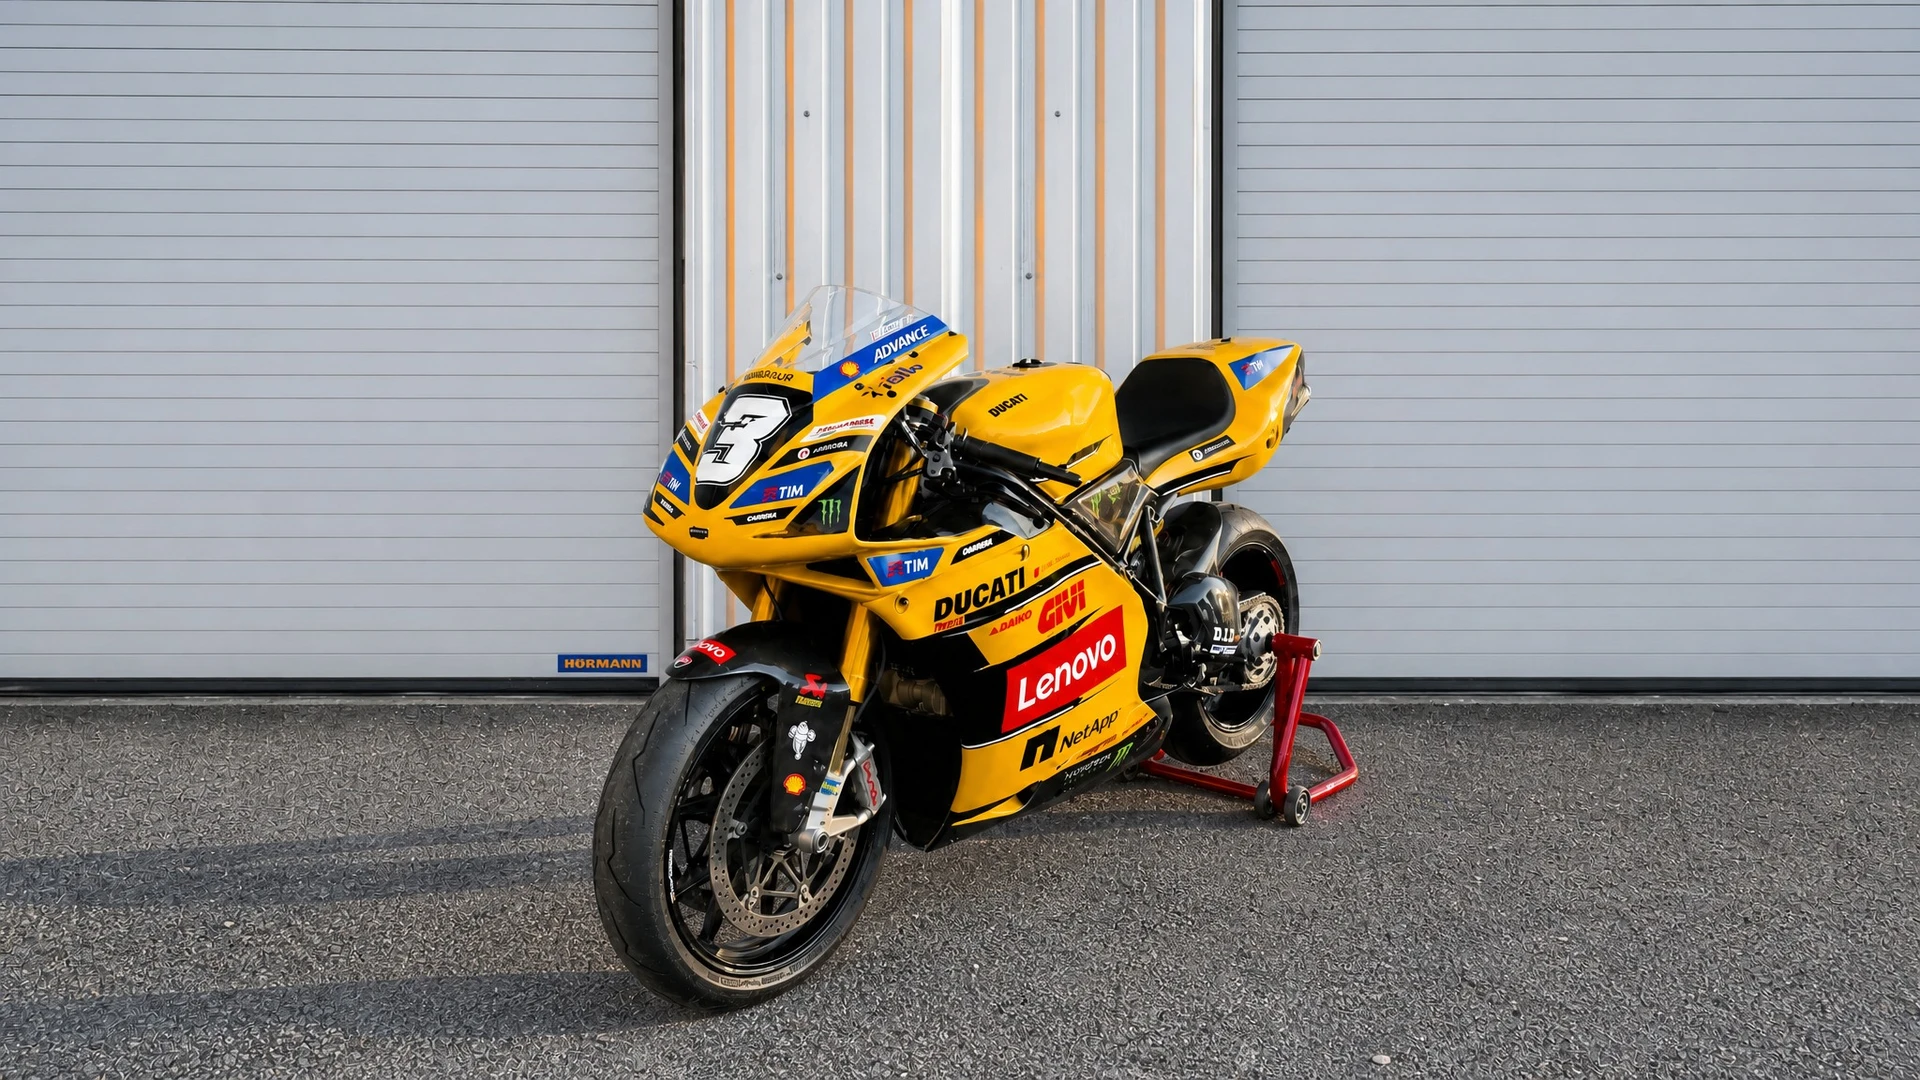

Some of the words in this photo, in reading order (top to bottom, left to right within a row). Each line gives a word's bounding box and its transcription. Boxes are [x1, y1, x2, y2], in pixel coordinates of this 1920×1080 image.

[874, 324, 930, 364] ADVANCE
[988, 393, 1028, 417] DUCATI
[695, 394, 792, 486] 3
[779, 484, 804, 499] TIM
[904, 557, 929, 574] TIM
[933, 566, 1025, 622] DUCATI
[1037, 578, 1087, 635] GIVI
[999, 609, 1032, 632] DAIKO
[564, 658, 642, 669] HÖRMANN
[1017, 633, 1117, 712] Lenovo
[1059, 709, 1119, 753] NetApp
